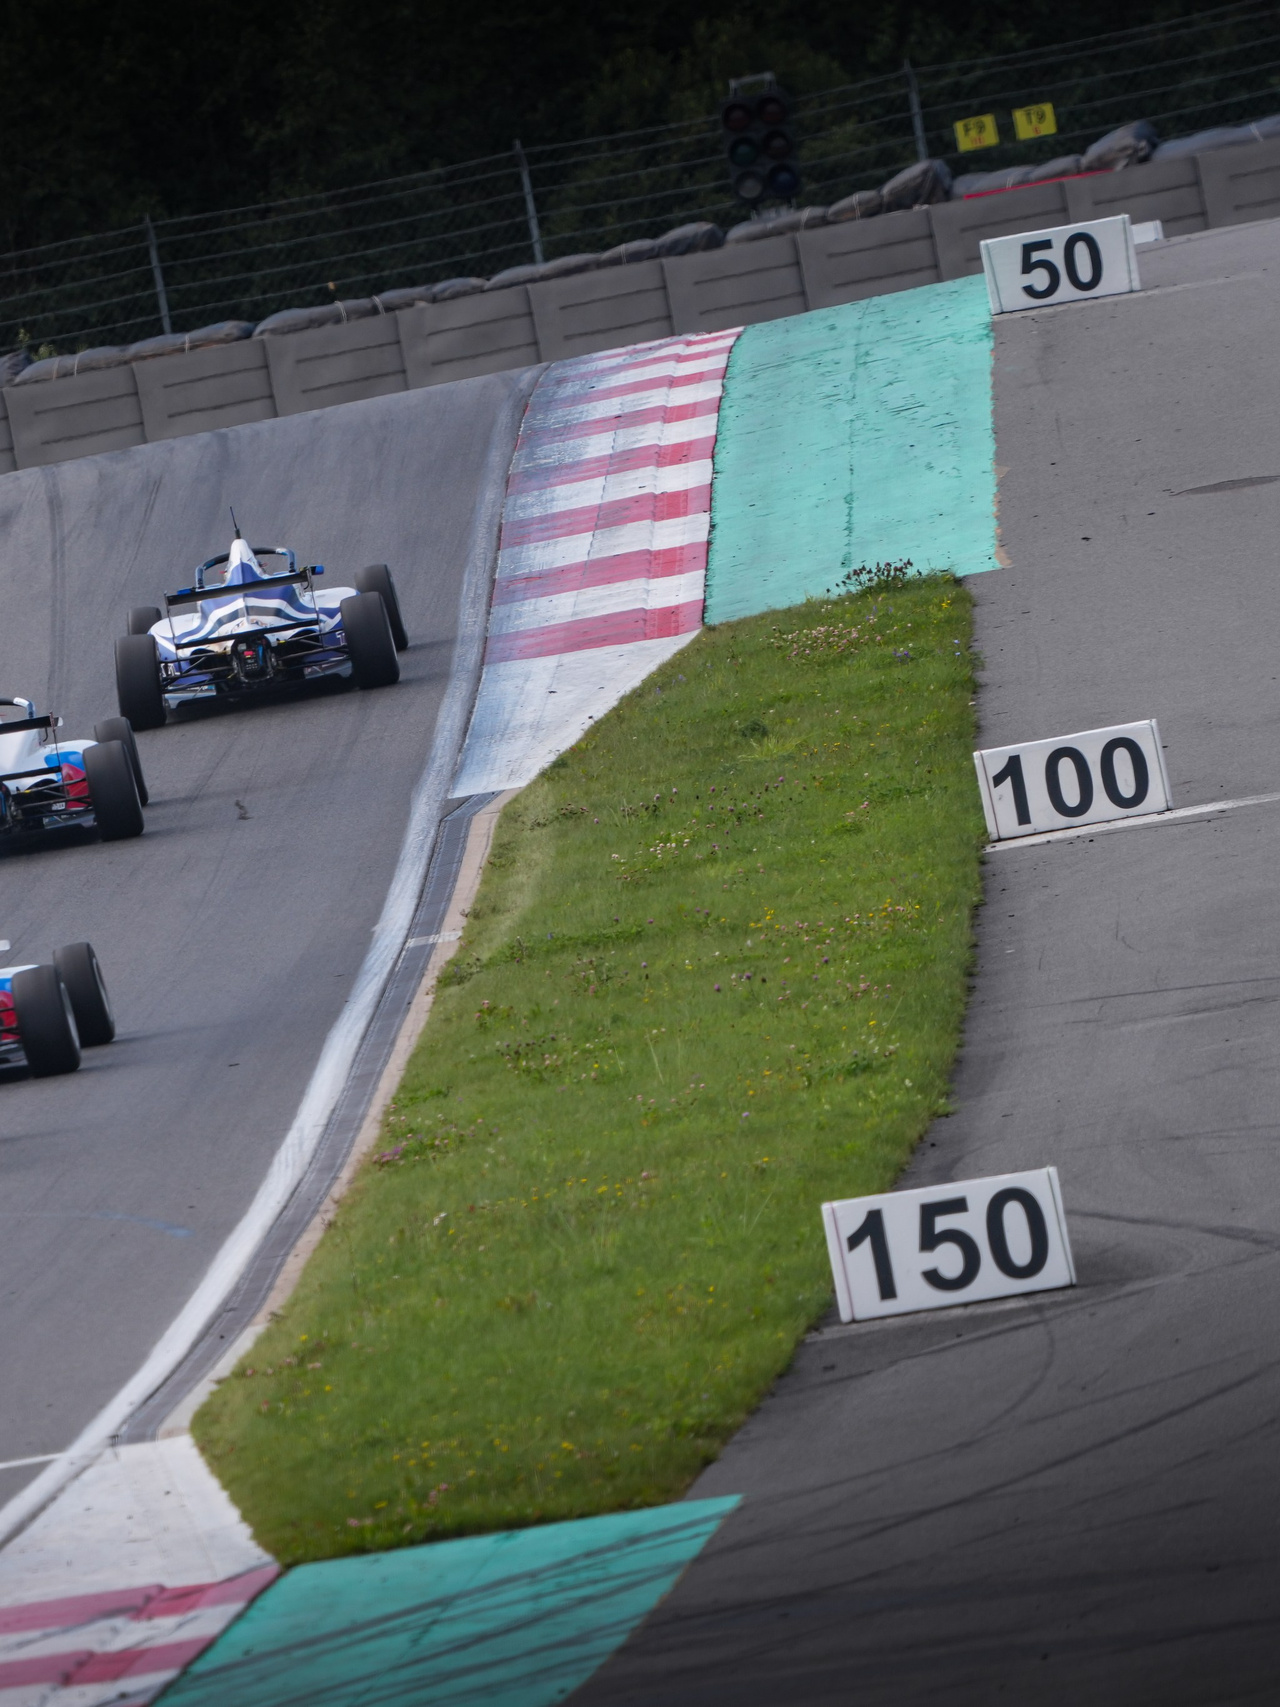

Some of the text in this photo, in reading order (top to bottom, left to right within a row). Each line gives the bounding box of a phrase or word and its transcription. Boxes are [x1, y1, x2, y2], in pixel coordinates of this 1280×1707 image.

[1021, 231, 1103, 300] 50
[991, 736, 1150, 827] 100
[846, 1186, 1049, 1302] 150
